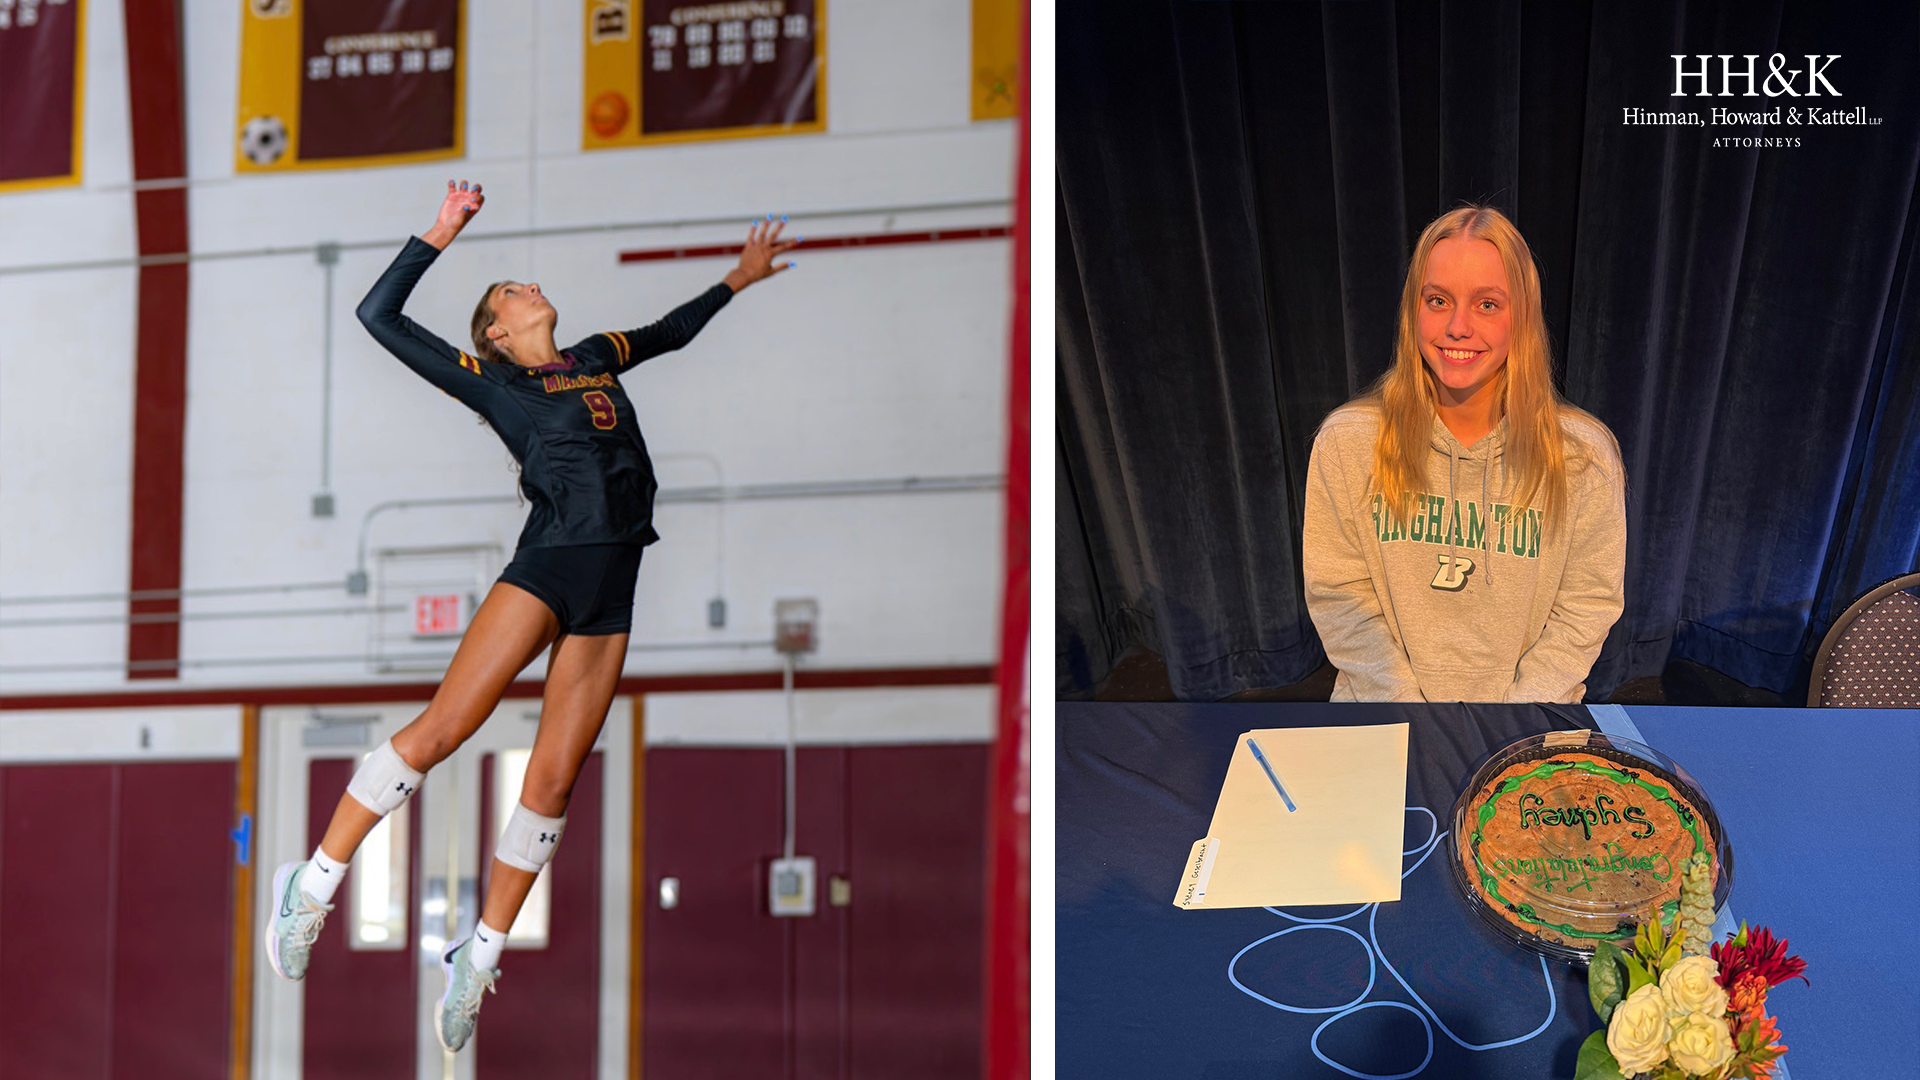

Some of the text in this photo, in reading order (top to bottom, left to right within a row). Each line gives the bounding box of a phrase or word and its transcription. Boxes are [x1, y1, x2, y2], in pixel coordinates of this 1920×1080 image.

[582, 390, 617, 430] 9
[1430, 554, 1476, 592] B
[415, 595, 459, 633] EXIT
[1519, 792, 1656, 840] Sydney
[1494, 842, 1674, 893] Congratulations
